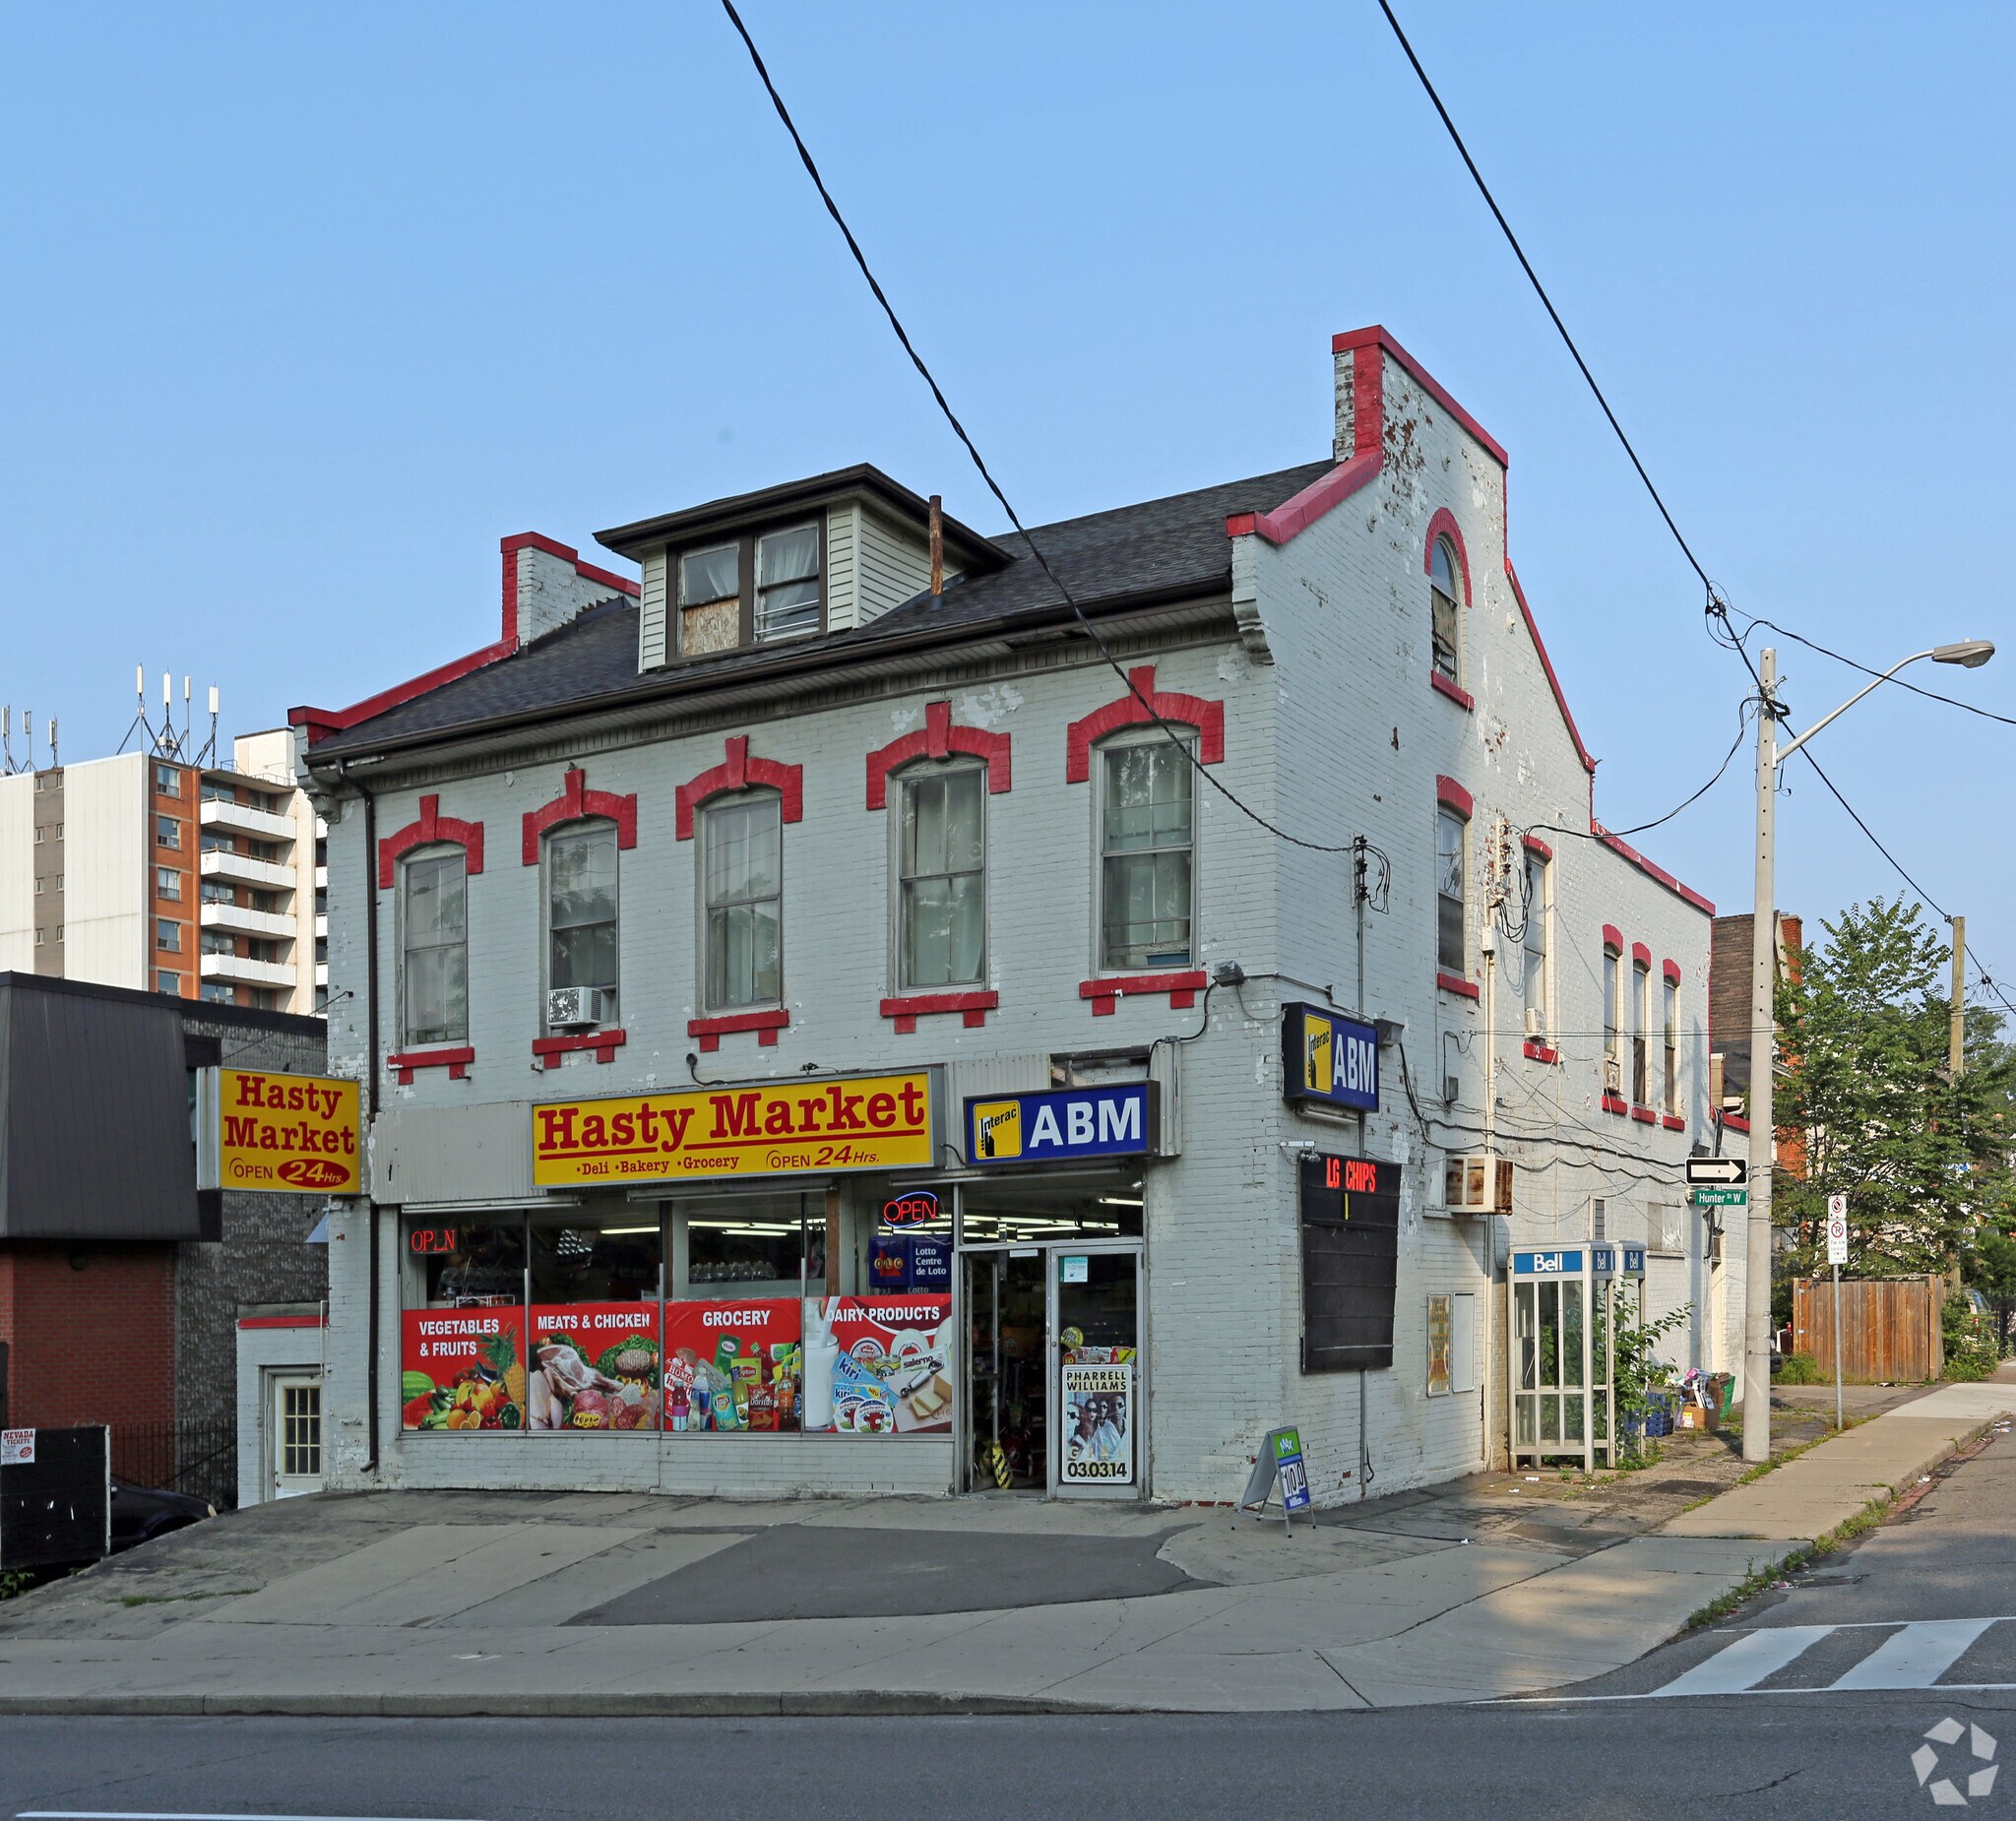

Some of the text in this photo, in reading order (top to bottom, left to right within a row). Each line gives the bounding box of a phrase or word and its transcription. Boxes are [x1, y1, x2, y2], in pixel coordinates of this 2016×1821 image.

[1333, 1034, 1375, 1095] ABM
[236, 1075, 343, 1120] Hasty
[537, 1082, 925, 1153] Hasty Market
[1029, 1097, 1141, 1149] ABM
[224, 1115, 355, 1155] Market
[771, 1155, 810, 1168] OPEN
[814, 1145, 852, 1166] 24
[233, 1164, 274, 1179] OPEN
[285, 1161, 324, 1182] 24
[1326, 1157, 1376, 1193] LG CHIPS
[1698, 1193, 1726, 1204] Hunter
[1732, 1194, 1741, 1203] W
[883, 1200, 937, 1222] OPEN
[915, 1247, 936, 1256] Lotto
[915, 1257, 942, 1266] Centre
[1534, 1253, 1563, 1272] Bell
[1597, 1252, 1606, 1270] Bell
[1629, 1252, 1638, 1269] Bell
[537, 1313, 650, 1330] MEATS & CHICKEN
[702, 1310, 771, 1327] GROCERY
[827, 1306, 940, 1322] DAIRY PRODUCTS
[419, 1319, 499, 1336] VEGETABLES
[419, 1342, 477, 1356] & FRUITS
[838, 1356, 862, 1381] kiri
[904, 1355, 933, 1369] salerno
[668, 1364, 694, 1384] HOMO
[1066, 1371, 1126, 1381] PHARRELL
[1067, 1381, 1126, 1390] WILLIAMS
[750, 1397, 773, 1406] Doritos
[4, 1430, 33, 1439] NEVADA
[1068, 1462, 1127, 1477] 03.03.14
